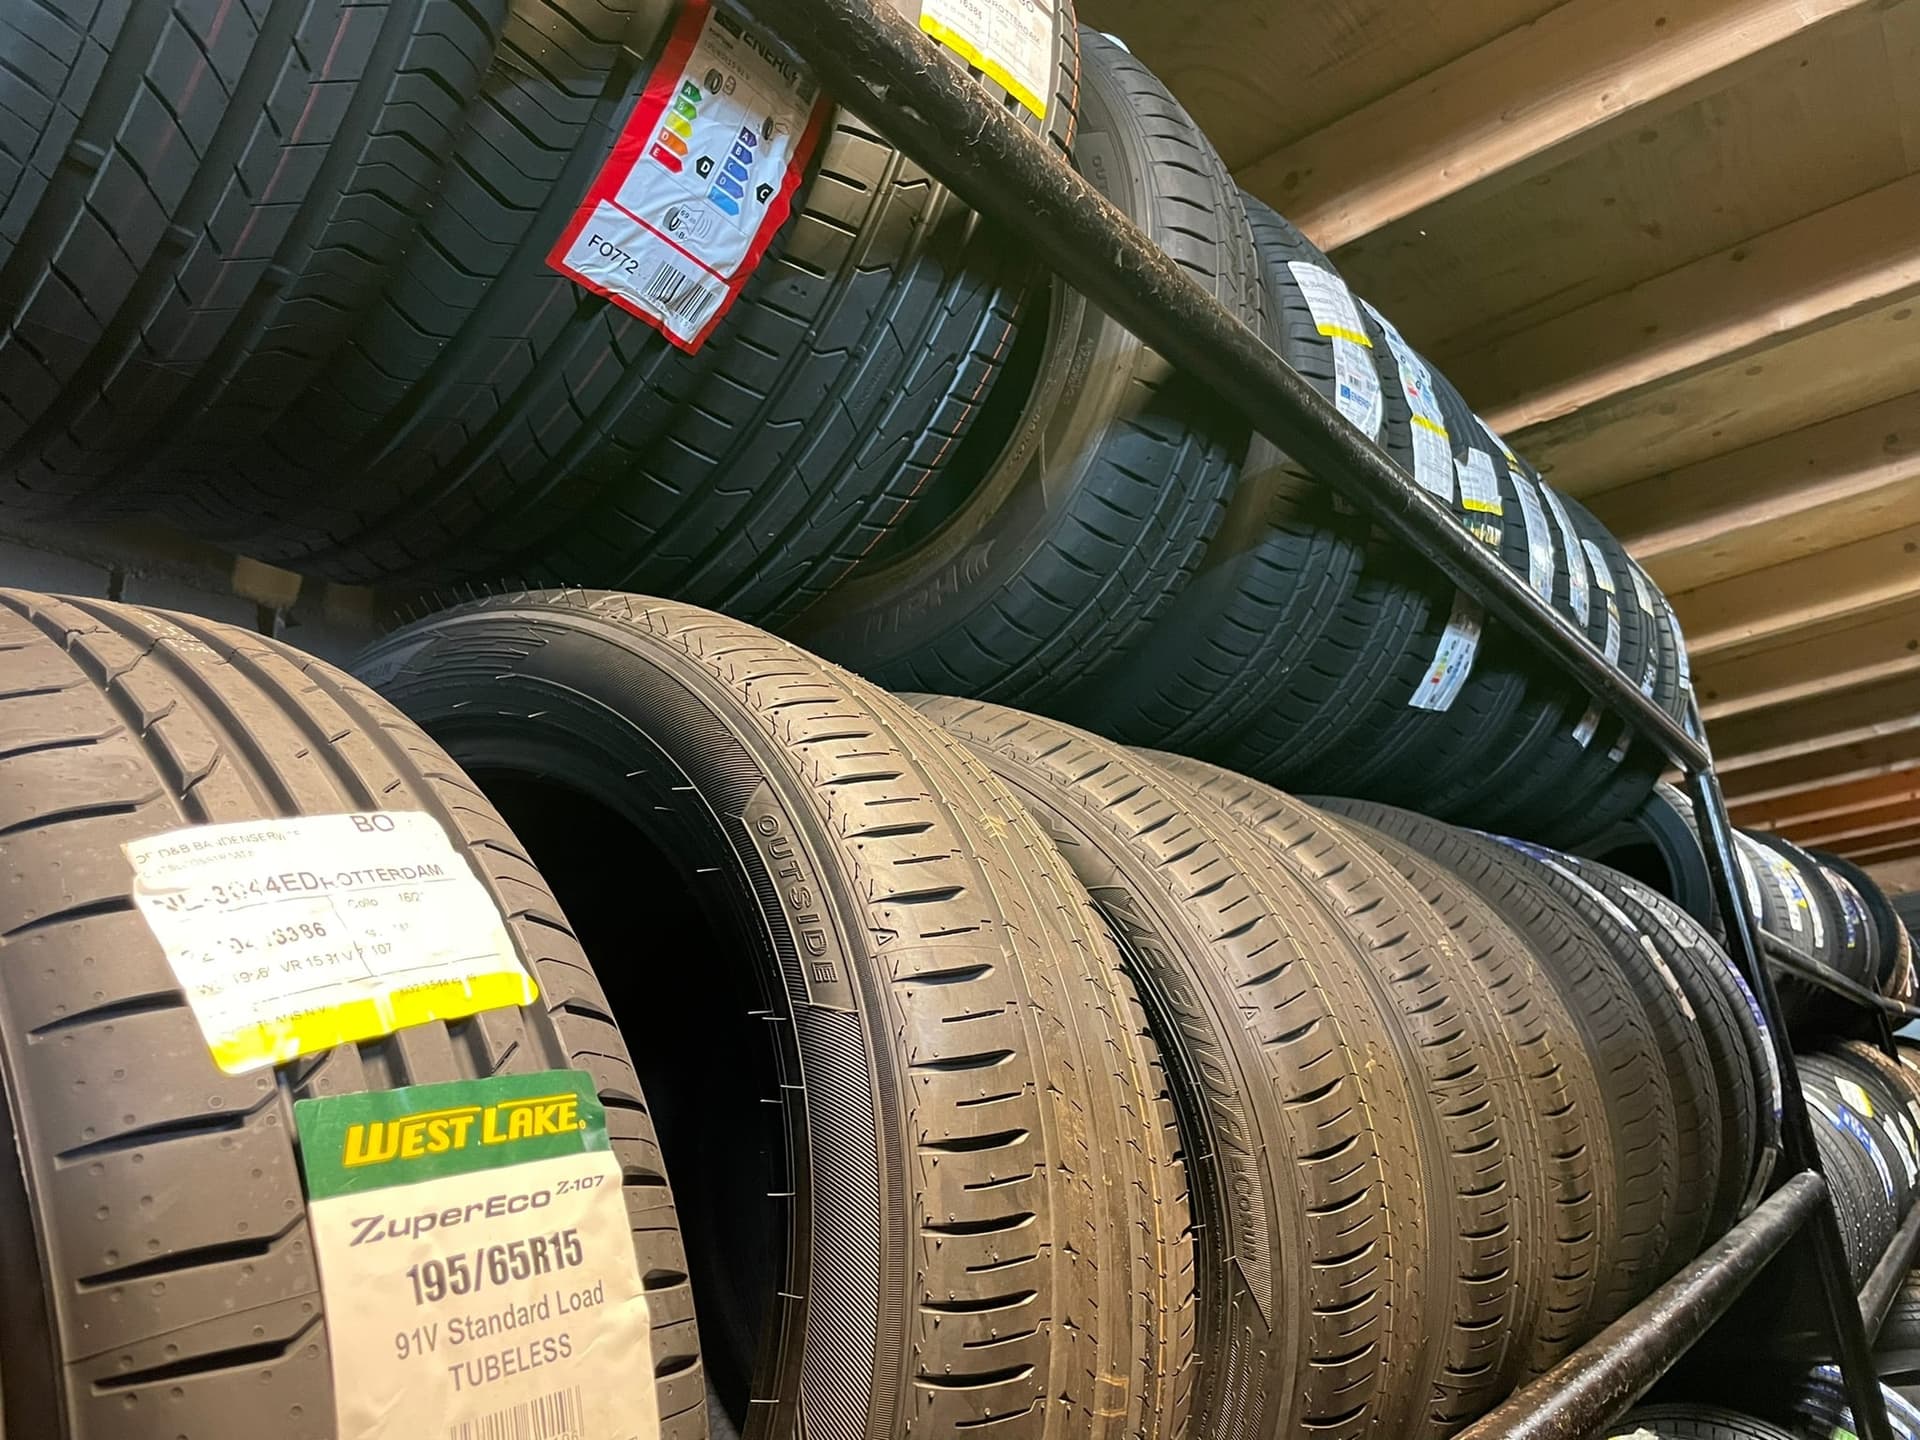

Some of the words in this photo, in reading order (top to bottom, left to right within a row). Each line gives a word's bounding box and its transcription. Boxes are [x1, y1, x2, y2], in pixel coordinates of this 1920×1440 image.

[700, 161, 711, 173] D
[350, 814, 395, 832] BO
[756, 814, 840, 984] OUTSIDE
[348, 1190, 551, 1247] ZuperEco
[555, 1175, 605, 1195] Z-107
[406, 1228, 584, 1306] 195/65R15
[395, 1323, 438, 1360] 91V
[447, 1294, 551, 1345] Standard
[556, 1279, 605, 1315] Load
[448, 1333, 573, 1392] TUBELESS
